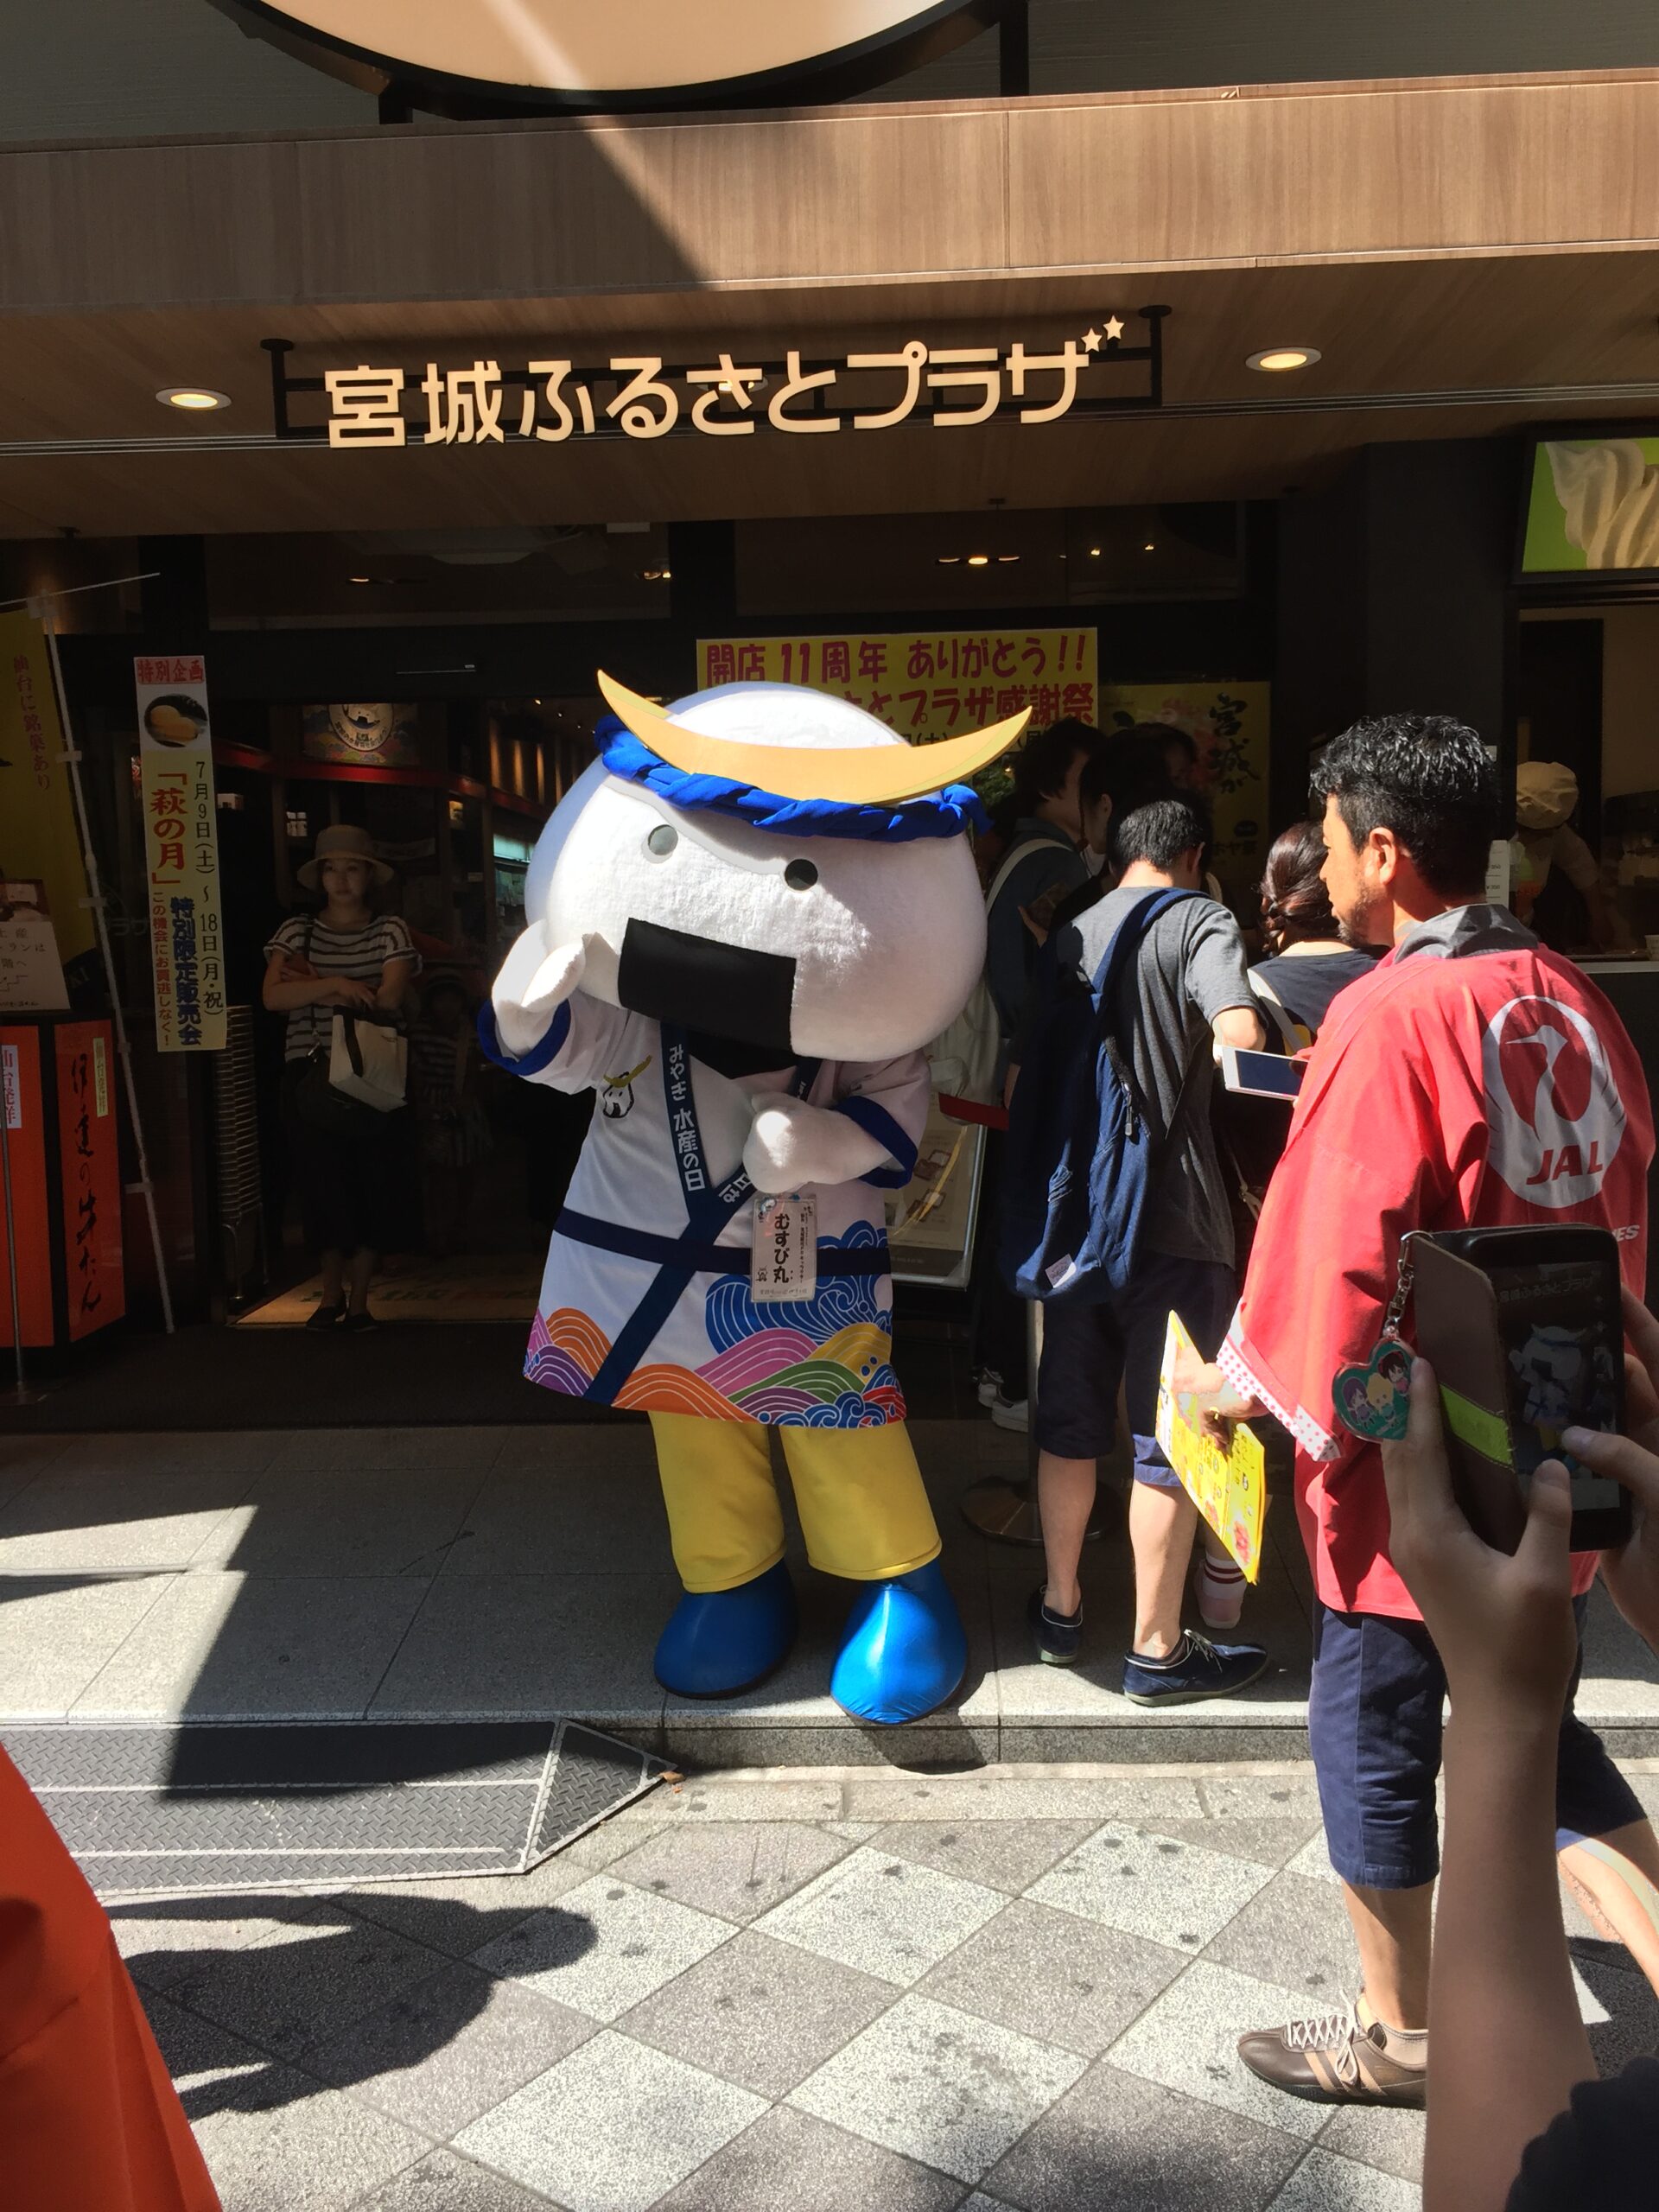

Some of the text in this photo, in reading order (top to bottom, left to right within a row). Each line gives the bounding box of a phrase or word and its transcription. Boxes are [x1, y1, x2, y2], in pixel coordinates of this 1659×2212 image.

[325, 316, 1126, 449] 宮城ふるさとプラザ
[137, 658, 205, 683] 特別企画
[149, 773, 188, 884] 「萩の月」
[170, 896, 203, 1046] 特別限定販売会
[668, 1044, 706, 1192] みやぎ 水産の日
[1526, 1140, 1604, 1186] JAL
[773, 1212, 791, 1284] むすび丸
[1612, 1224, 1640, 1242] ES
